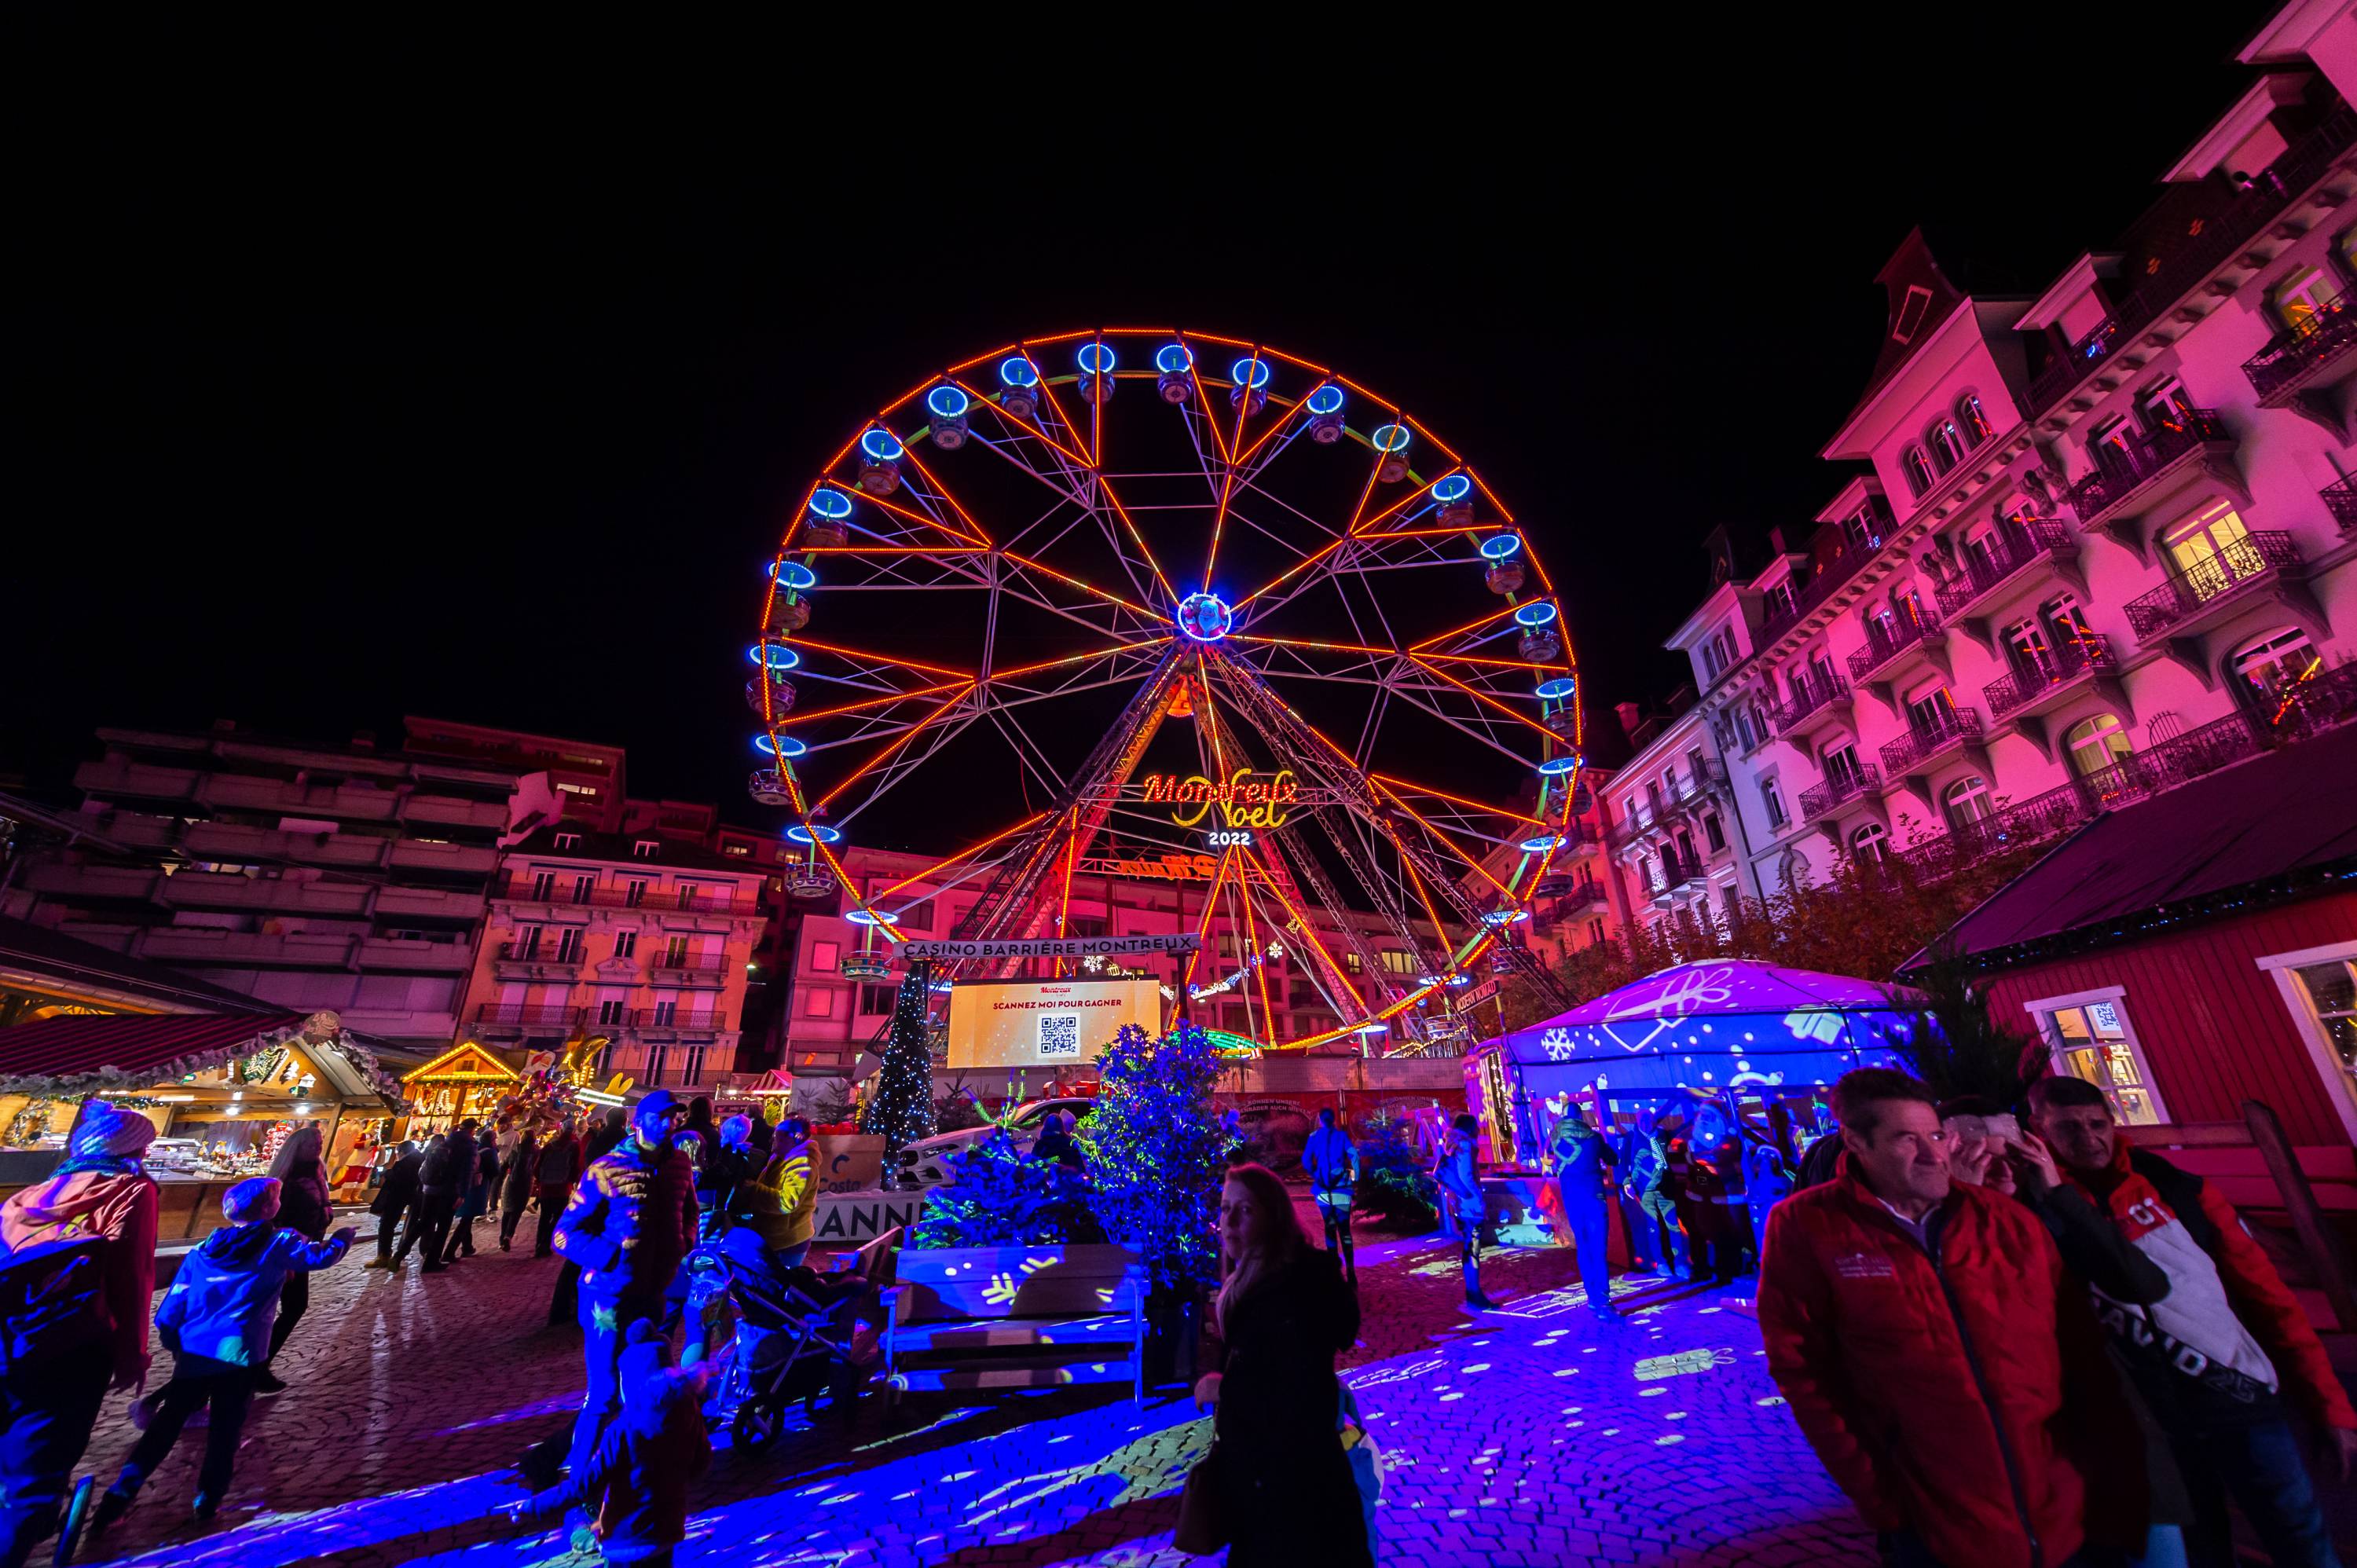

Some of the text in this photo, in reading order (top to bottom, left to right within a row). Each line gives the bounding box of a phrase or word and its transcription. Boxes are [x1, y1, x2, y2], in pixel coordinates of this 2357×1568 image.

[1143, 775, 1297, 803] Montreux
[1208, 832, 1251, 846] 2022
[904, 937, 1193, 956] CASINO BARRIÈRE MONTREUX
[1474, 980, 1497, 1002] NOMAD
[993, 1002, 1036, 1010] SCANNEZ
[819, 1177, 861, 1192] Costa
[814, 1202, 930, 1237] ANN
